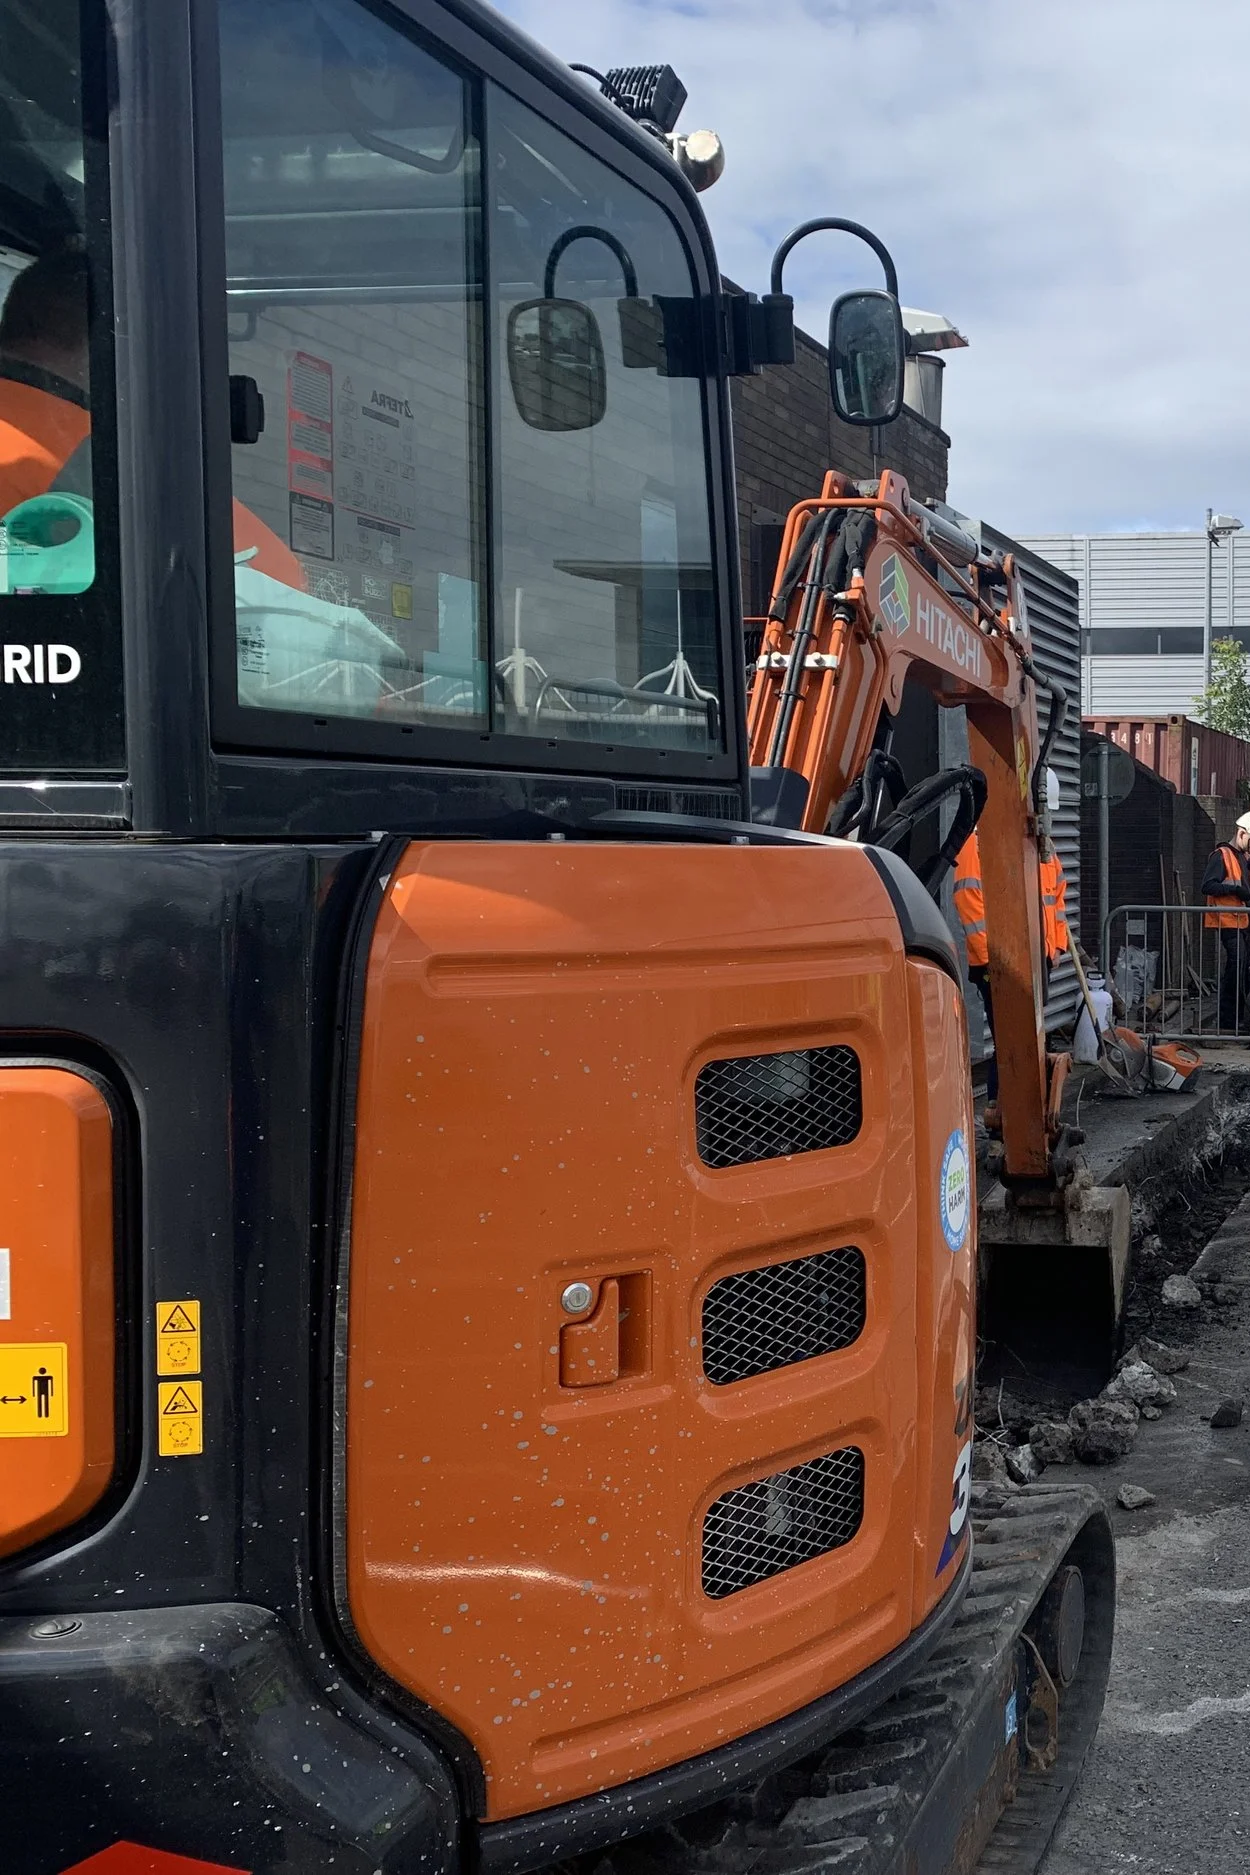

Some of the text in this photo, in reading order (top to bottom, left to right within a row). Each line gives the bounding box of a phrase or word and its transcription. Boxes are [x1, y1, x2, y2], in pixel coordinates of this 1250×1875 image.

[916, 592, 981, 678] HITACHI
[2, 645, 82, 684] RID
[948, 1165, 966, 1192] ZERO
[948, 1186, 966, 1213] HARM
